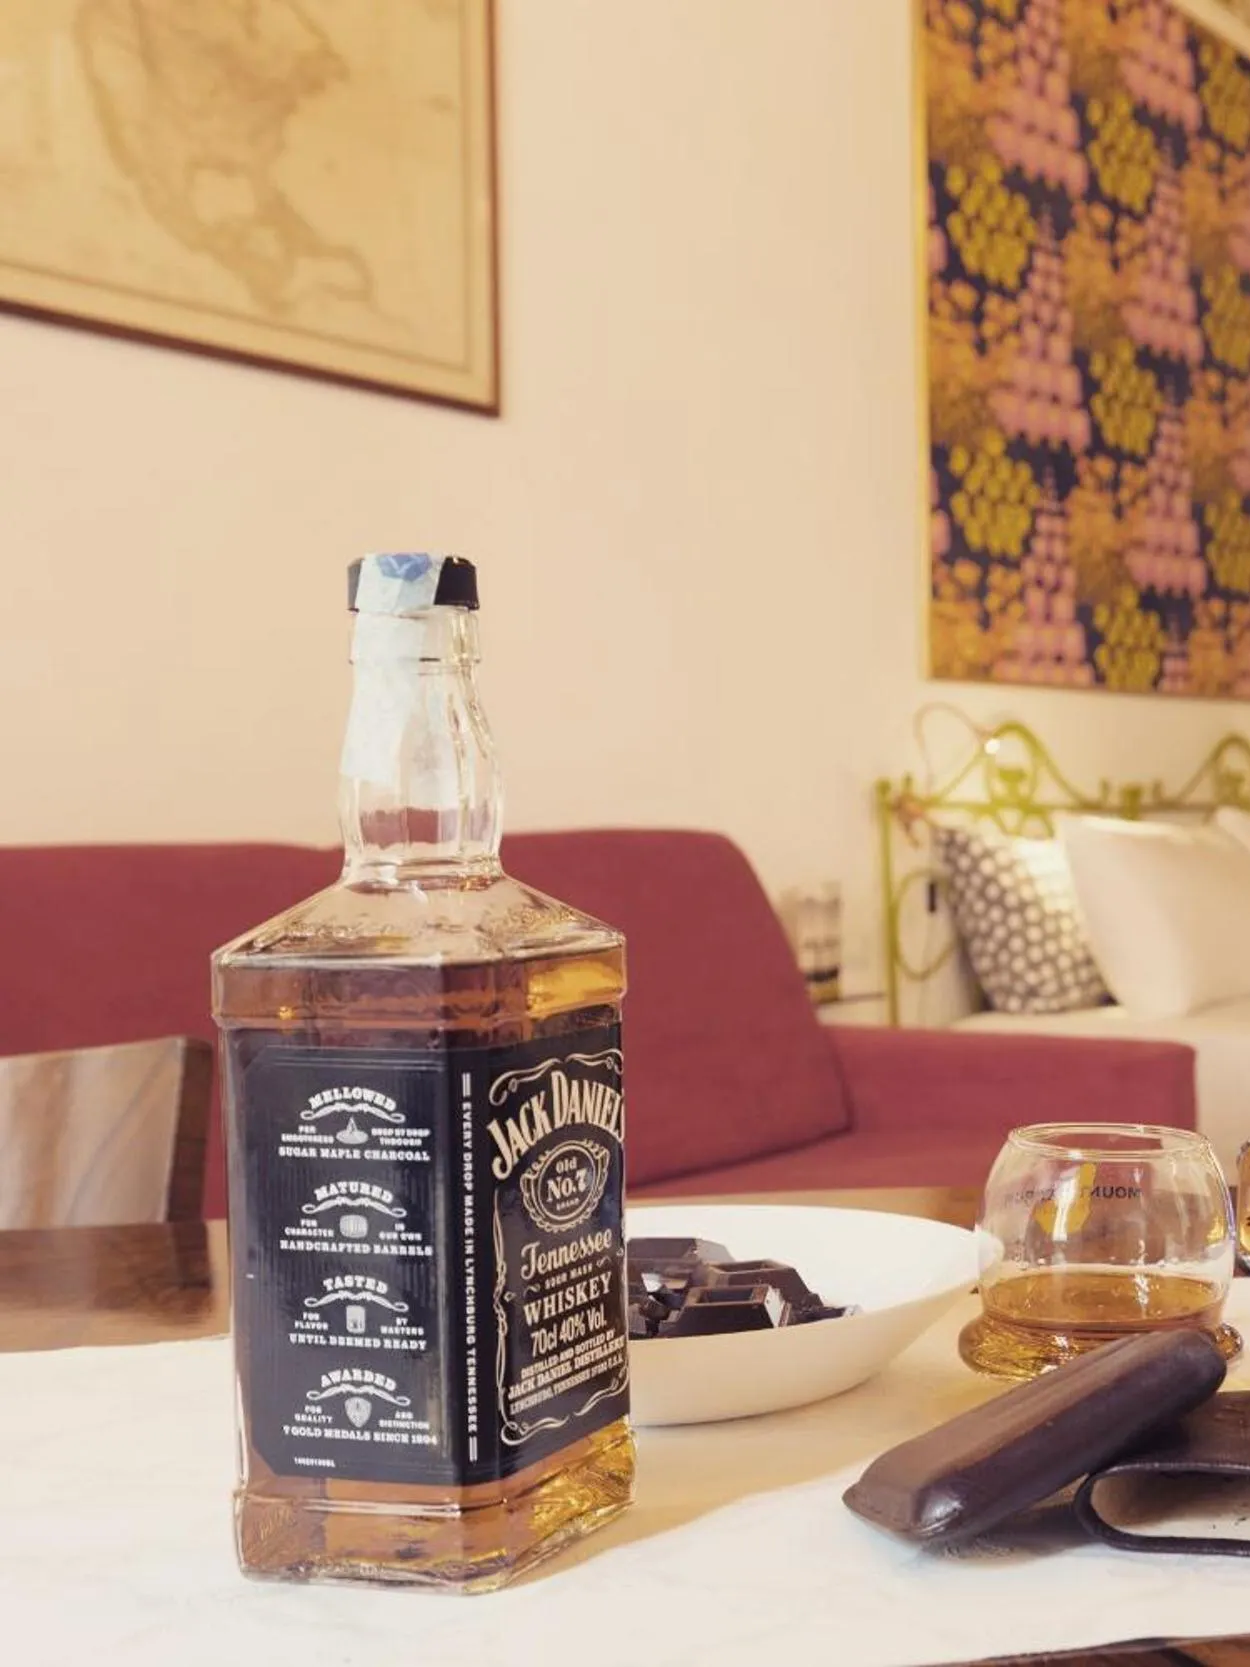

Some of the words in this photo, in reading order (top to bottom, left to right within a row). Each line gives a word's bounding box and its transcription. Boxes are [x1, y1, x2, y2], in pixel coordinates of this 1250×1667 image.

[308, 1086, 397, 1112] MELLOWED
[461, 1102, 473, 1149] EVERY
[486, 1089, 553, 1180] JACK
[551, 1070, 625, 1143] DANIEL
[278, 1146, 317, 1158] SUGAR
[320, 1147, 361, 1159] MAPLE
[364, 1149, 431, 1161] CHARCOAL
[463, 1152, 474, 1191] DROP
[555, 1156, 577, 1174] Old
[313, 1181, 394, 1204] MATURED
[464, 1195, 475, 1235] MADE
[280, 1239, 371, 1254] HANDCRAFTED
[373, 1244, 433, 1256] BARRELS
[464, 1239, 475, 1255] IN
[520, 1228, 613, 1281] Tennessee
[323, 1275, 388, 1294] TASTED
[464, 1258, 476, 1344] LYNCHBURG
[523, 1271, 613, 1327] WHISKEY
[289, 1333, 327, 1345] UNTIL
[329, 1336, 381, 1348] DEEMED
[383, 1338, 427, 1350] READY
[531, 1321, 558, 1358] 70cl
[559, 1311, 586, 1344] 40%
[587, 1303, 607, 1332] Vol.
[521, 1354, 560, 1380] DISTILLED
[574, 1332, 606, 1355] BOTTLED
[606, 1328, 615, 1342] BY
[320, 1368, 397, 1391] AWARDED
[466, 1348, 478, 1433] TENNESSEE
[508, 1377, 536, 1401] JACK
[536, 1360, 573, 1388] DANIEL
[291, 1426, 322, 1438] GOLD
[324, 1428, 371, 1441] MEDALS
[373, 1431, 410, 1444] SINCE
